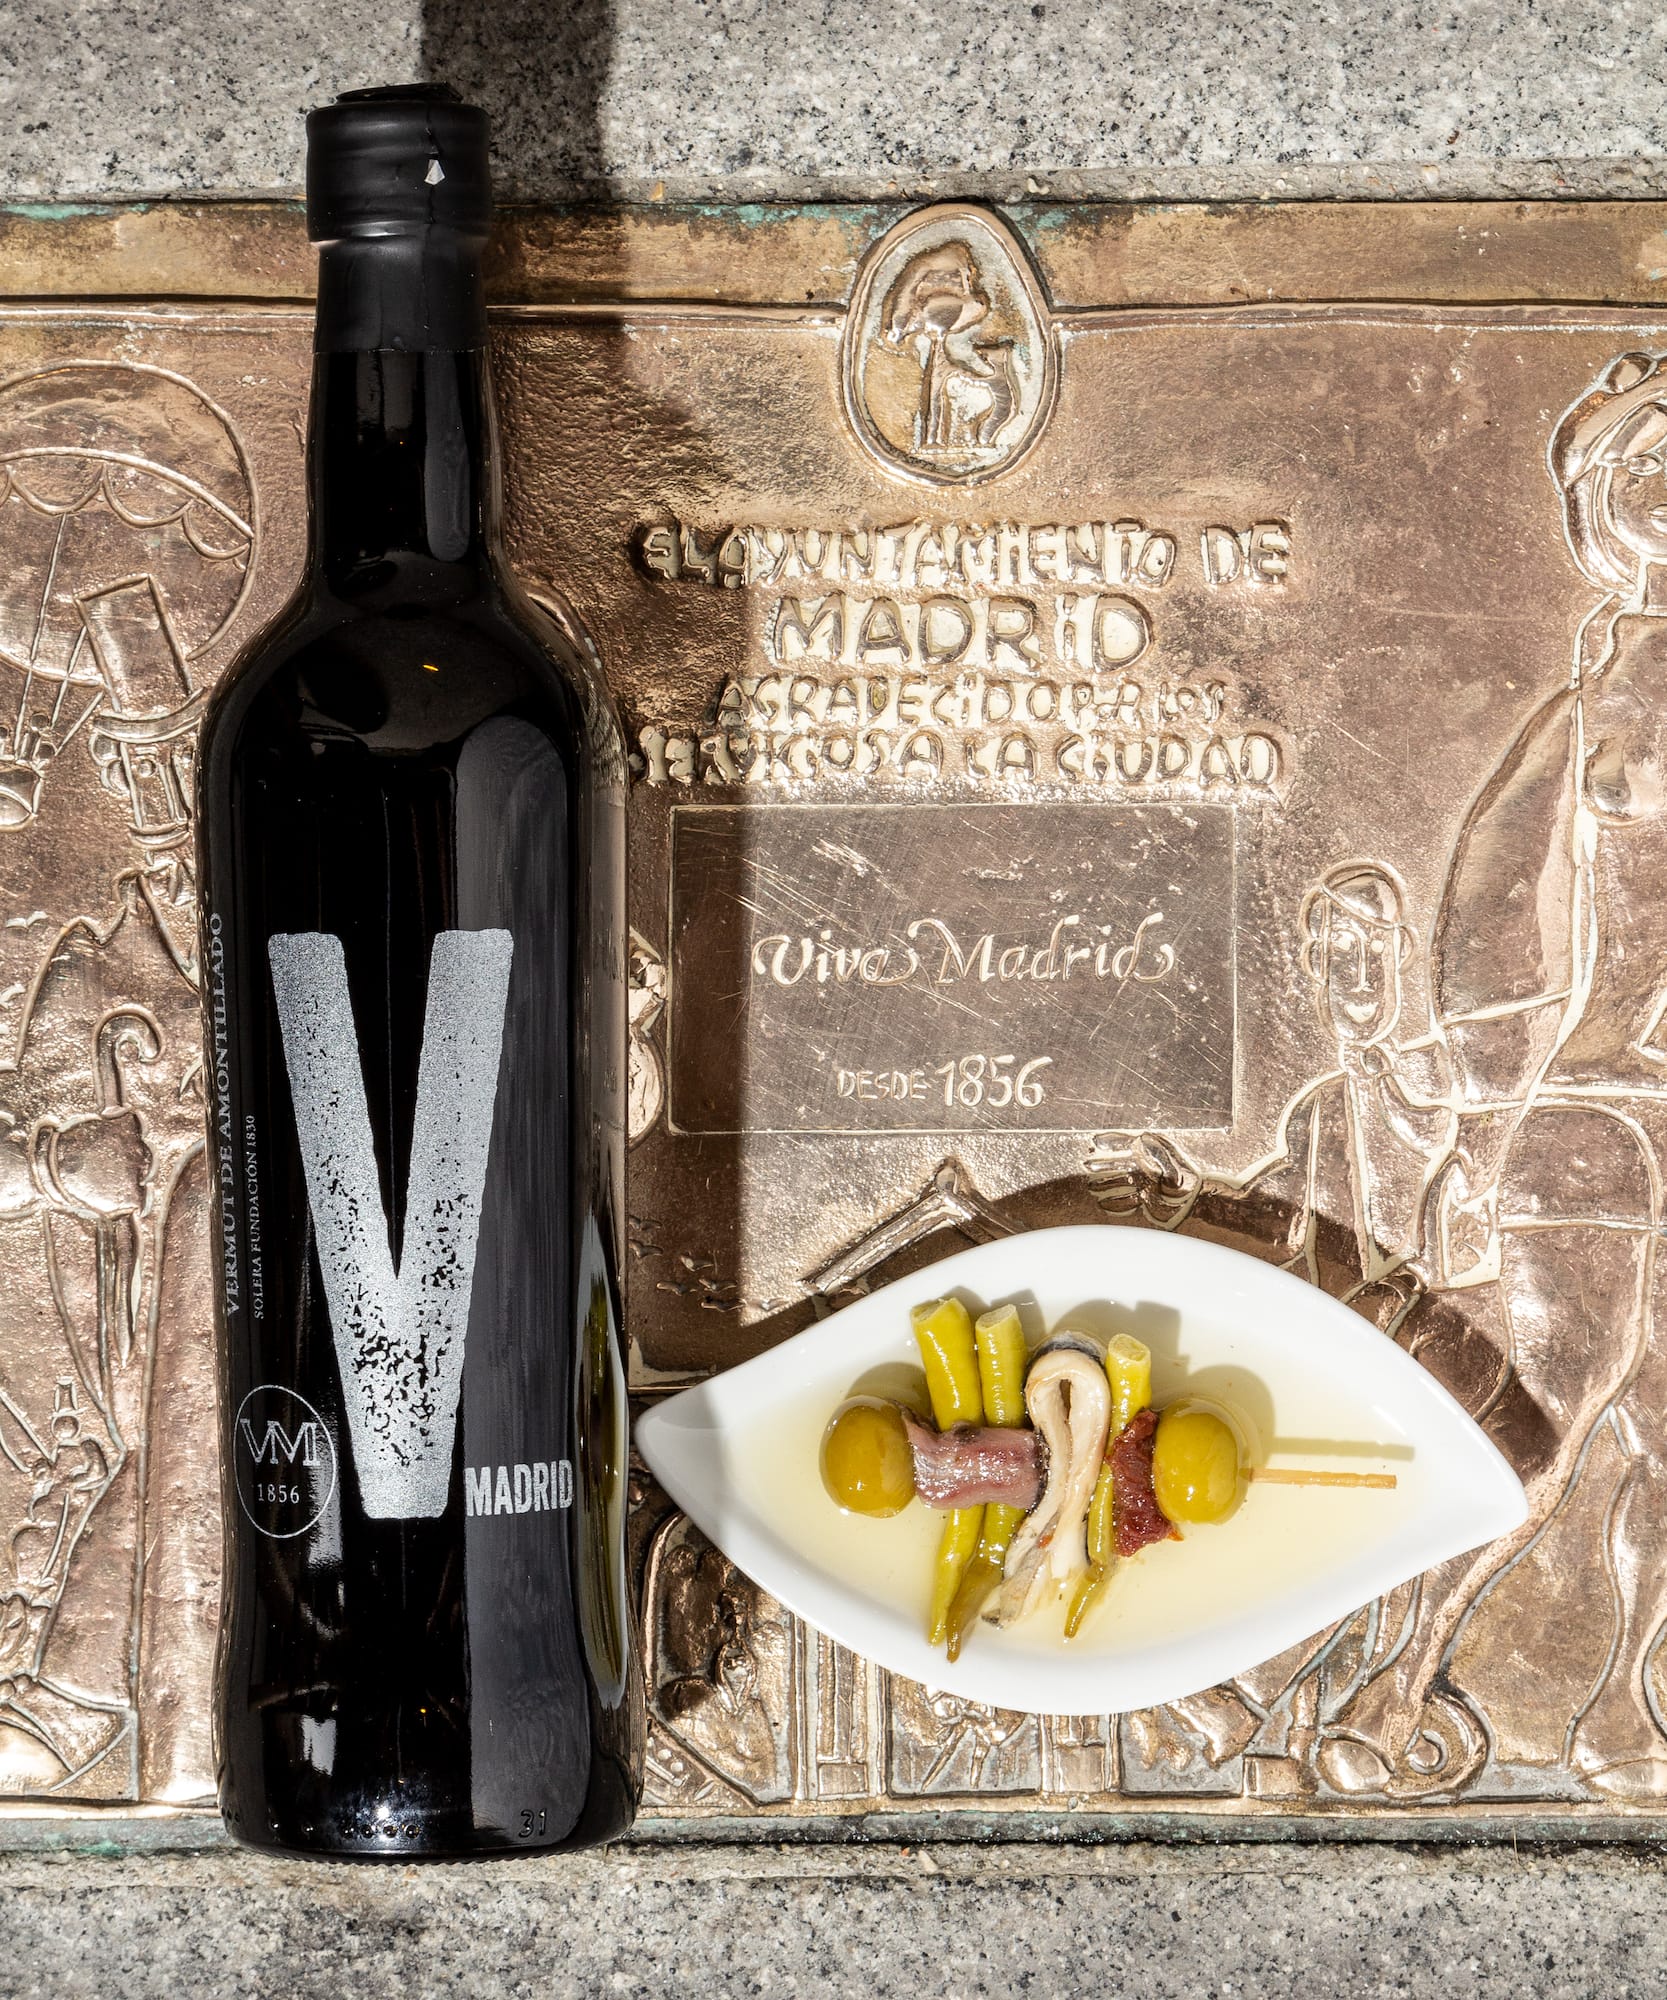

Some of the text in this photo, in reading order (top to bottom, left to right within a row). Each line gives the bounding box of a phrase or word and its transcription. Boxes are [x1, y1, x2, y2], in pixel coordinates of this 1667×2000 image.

[641, 519, 1290, 588] EL AYUNTAMIENTO DE
[770, 591, 1153, 673] MADRID
[716, 673, 1060, 726] AGRADECIDO
[963, 731, 1038, 781] LA
[1054, 729, 1283, 785] CIUDAD
[752, 911, 1176, 987] Viva Madrid
[210, 912, 240, 1316] VERMUT DE AMONTILLADO
[837, 1053, 1053, 1110] DESDE 1856
[245, 1115, 264, 1319] SOLERA FUNDACIÓN 1830
[267, 928, 514, 1519] V
[256, 1483, 300, 1504] 1856
[464, 1459, 573, 1516] MADRID
